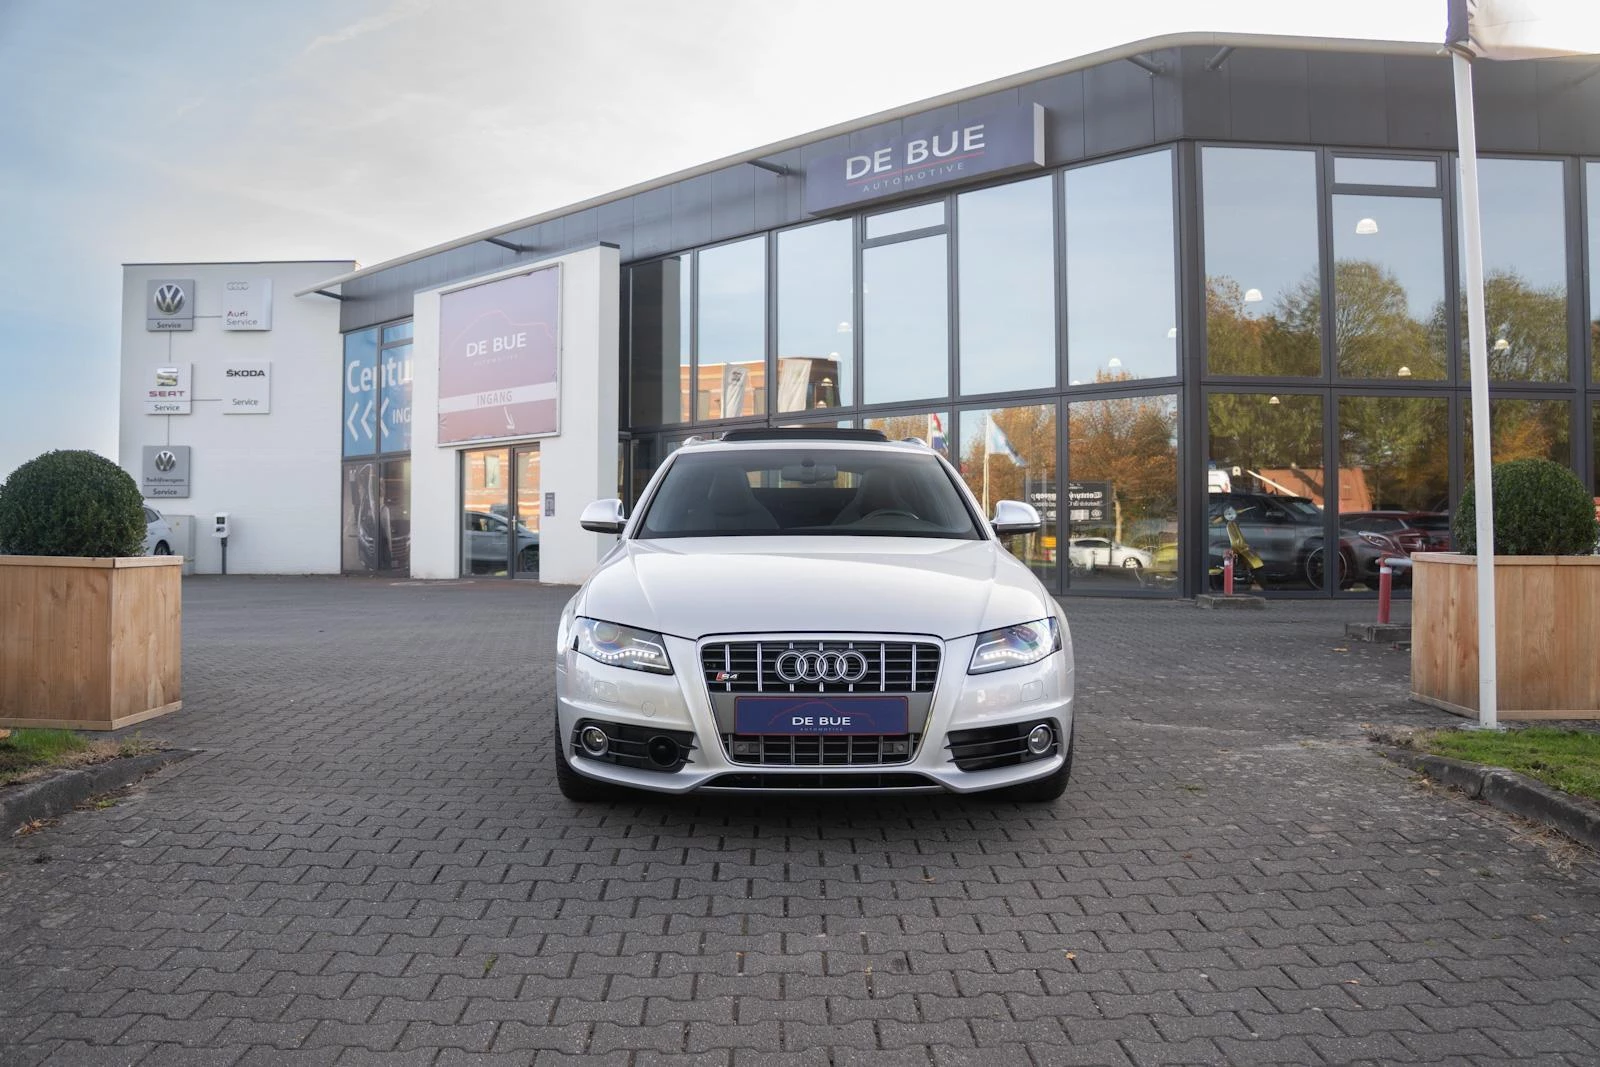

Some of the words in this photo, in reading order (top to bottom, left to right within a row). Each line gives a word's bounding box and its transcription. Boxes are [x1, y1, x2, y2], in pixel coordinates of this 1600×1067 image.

[846, 147, 893, 181] DE
[906, 124, 986, 165] BUE
[862, 162, 965, 193] AUTOMOTIVE
[226, 310, 249, 318] Audi
[156, 321, 182, 330] Service
[226, 318, 258, 326] Service
[466, 340, 488, 358] DE
[492, 332, 528, 353] BUE
[226, 369, 266, 378] ŠKODA
[148, 390, 185, 398] SEAT
[476, 390, 513, 406] INGANG
[154, 402, 181, 412] Service
[231, 398, 259, 407] Service
[152, 488, 178, 496] Service
[791, 716, 814, 726] DE
[818, 716, 852, 726] BUE
